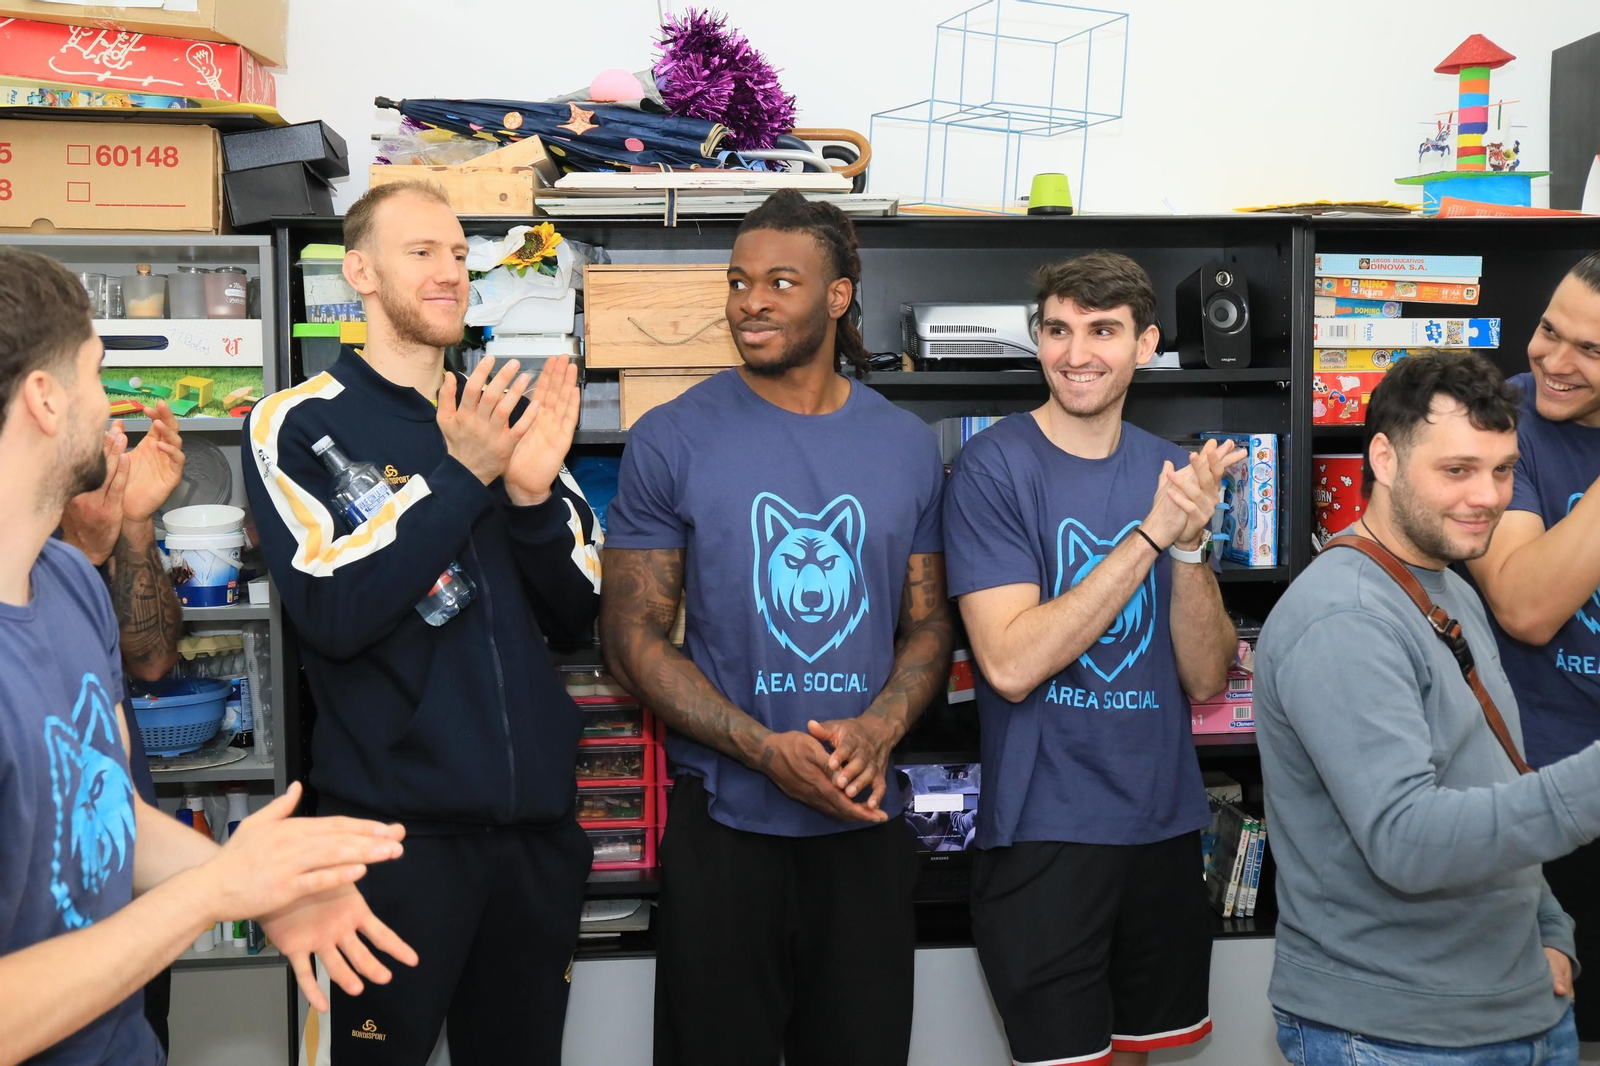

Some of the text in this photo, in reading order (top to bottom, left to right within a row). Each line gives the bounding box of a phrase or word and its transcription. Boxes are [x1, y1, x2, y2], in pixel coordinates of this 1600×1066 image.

[95, 145, 179, 168] 60148
[1370, 263, 1406, 271] DINOVA
[1360, 287, 1383, 298] figura
[1354, 307, 1381, 315] DOMINO
[1366, 323, 1374, 341] Puzzle
[1555, 648, 1600, 675] ÁRE
[755, 670, 868, 695] ÁEA SOCIAL
[1045, 680, 1160, 710] ÁREA SOCIAL
